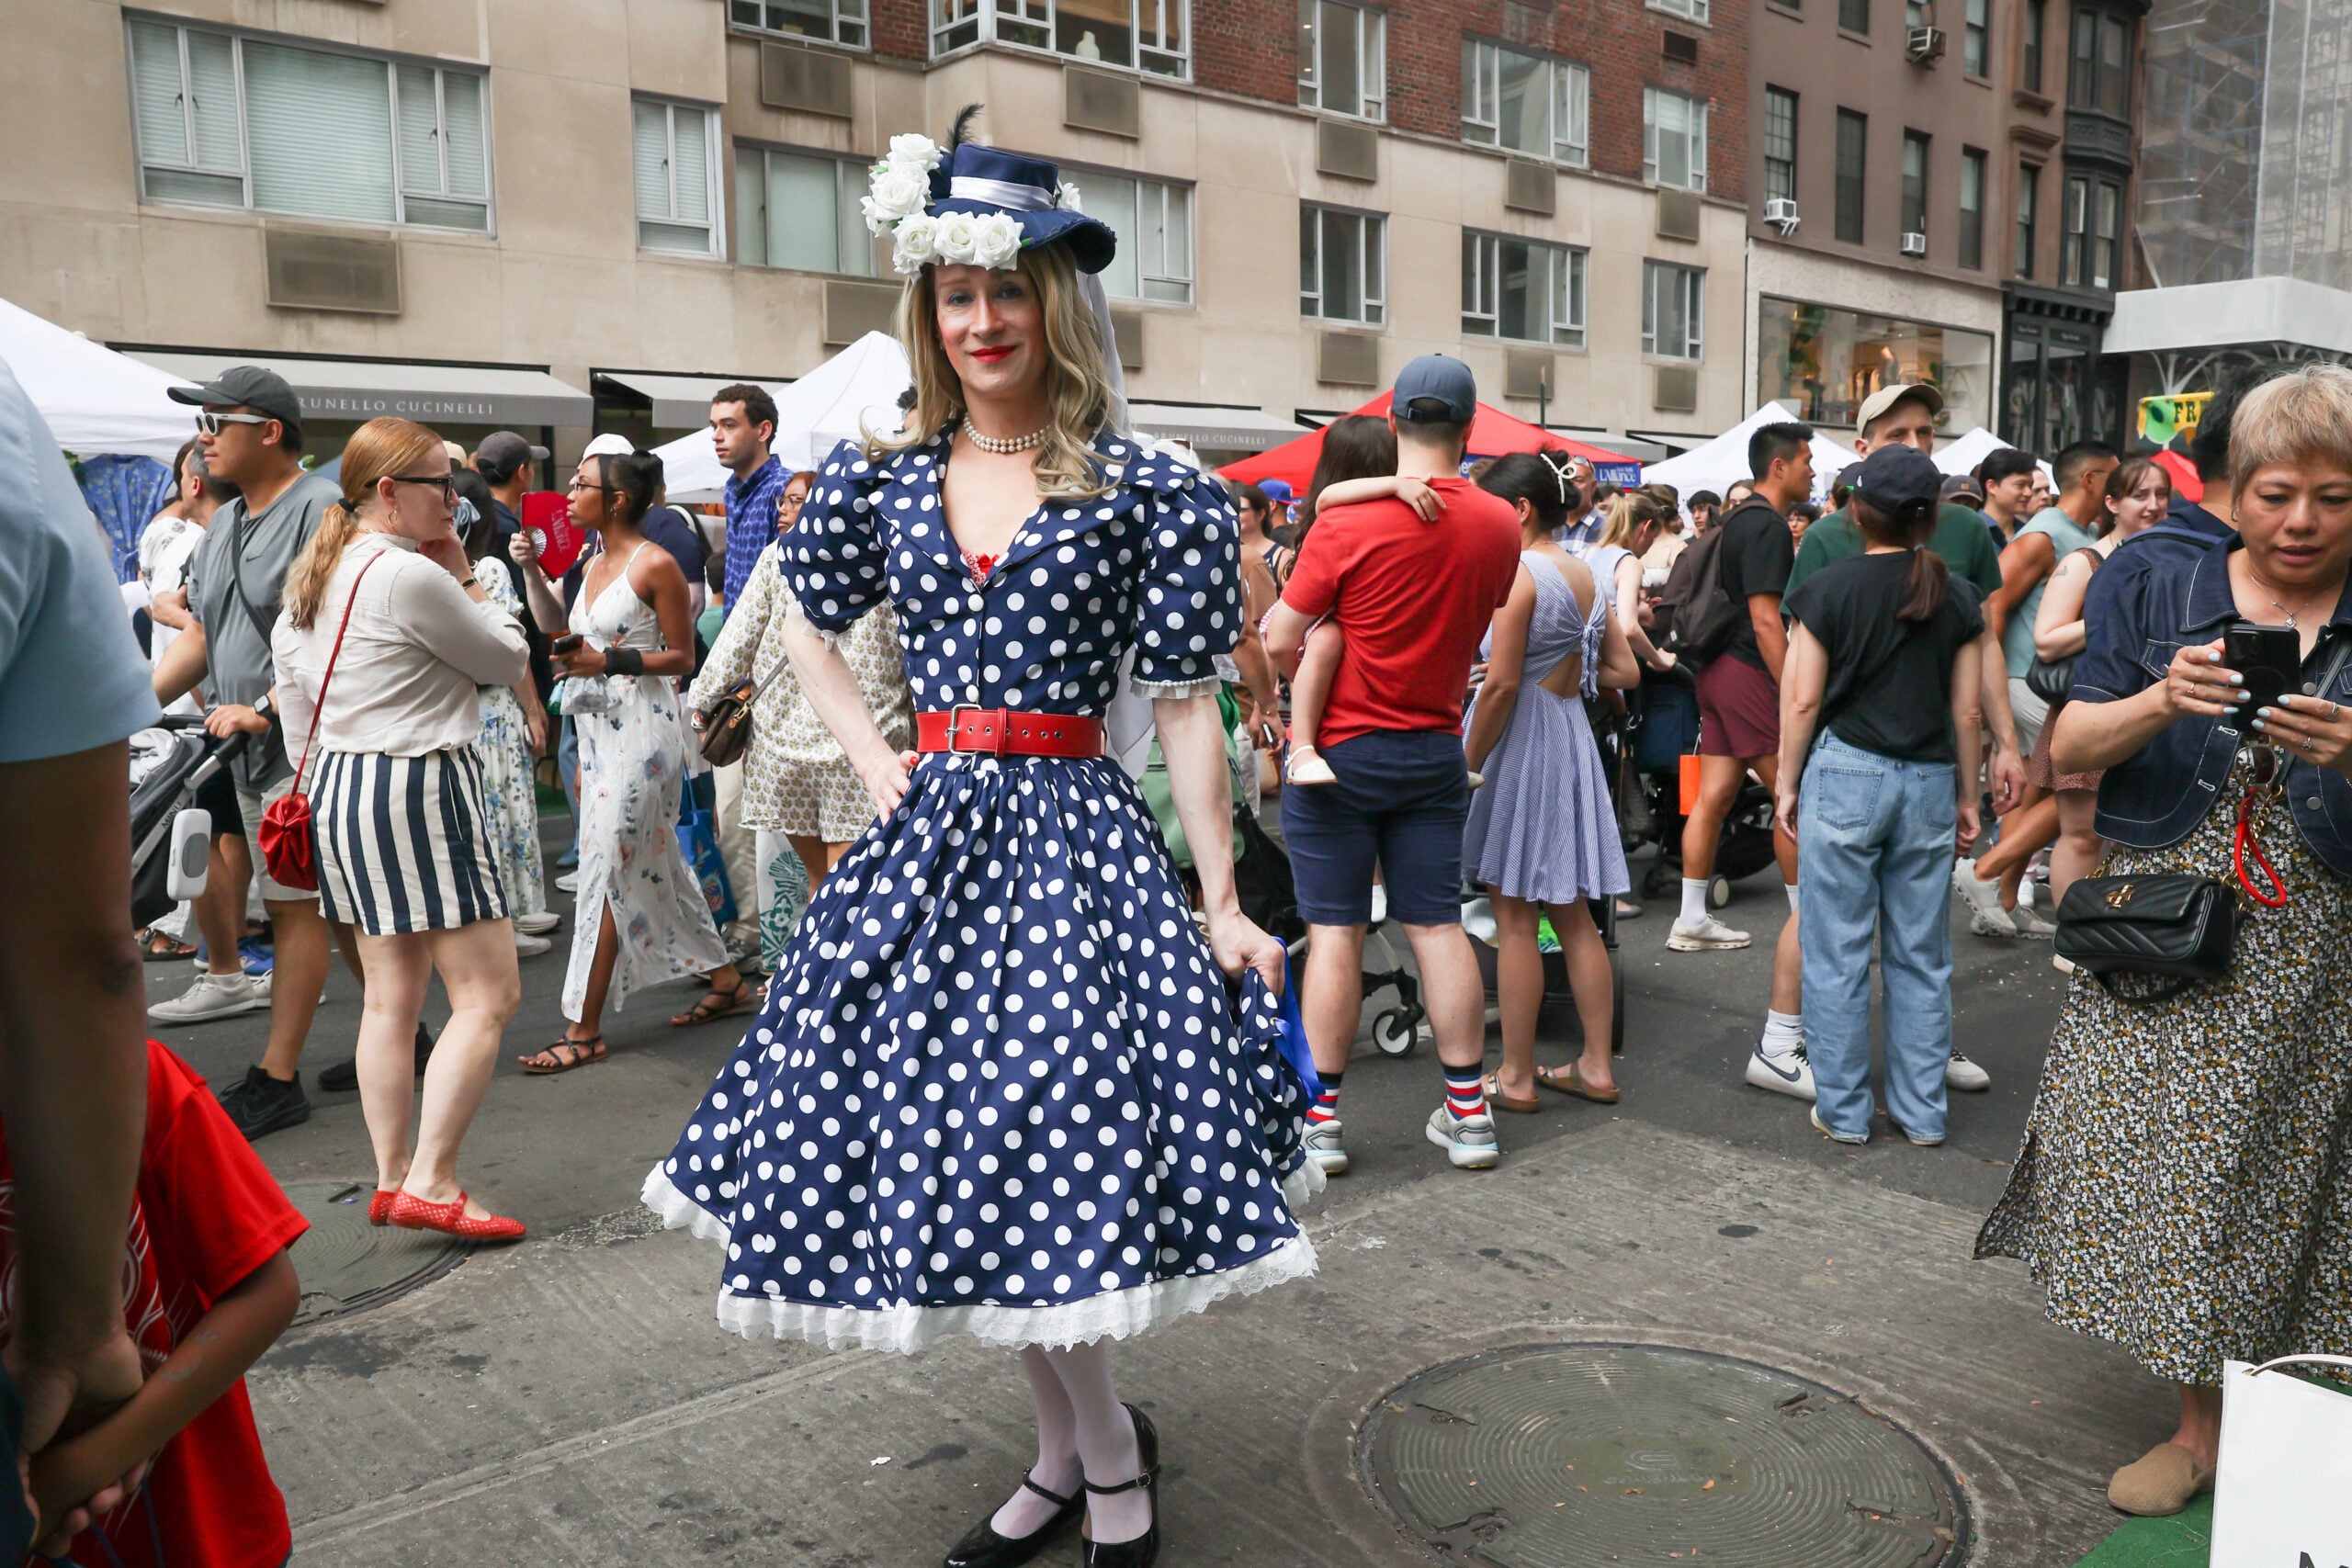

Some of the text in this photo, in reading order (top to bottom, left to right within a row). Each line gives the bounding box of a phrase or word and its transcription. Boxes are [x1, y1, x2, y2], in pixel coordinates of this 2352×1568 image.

[298, 397, 493, 414] RUNELLO CUCINELLI
[2174, 400, 2205, 423] FR
[1213, 434, 1265, 445] CUCINELLI
[162, 801, 182, 829] MINU
